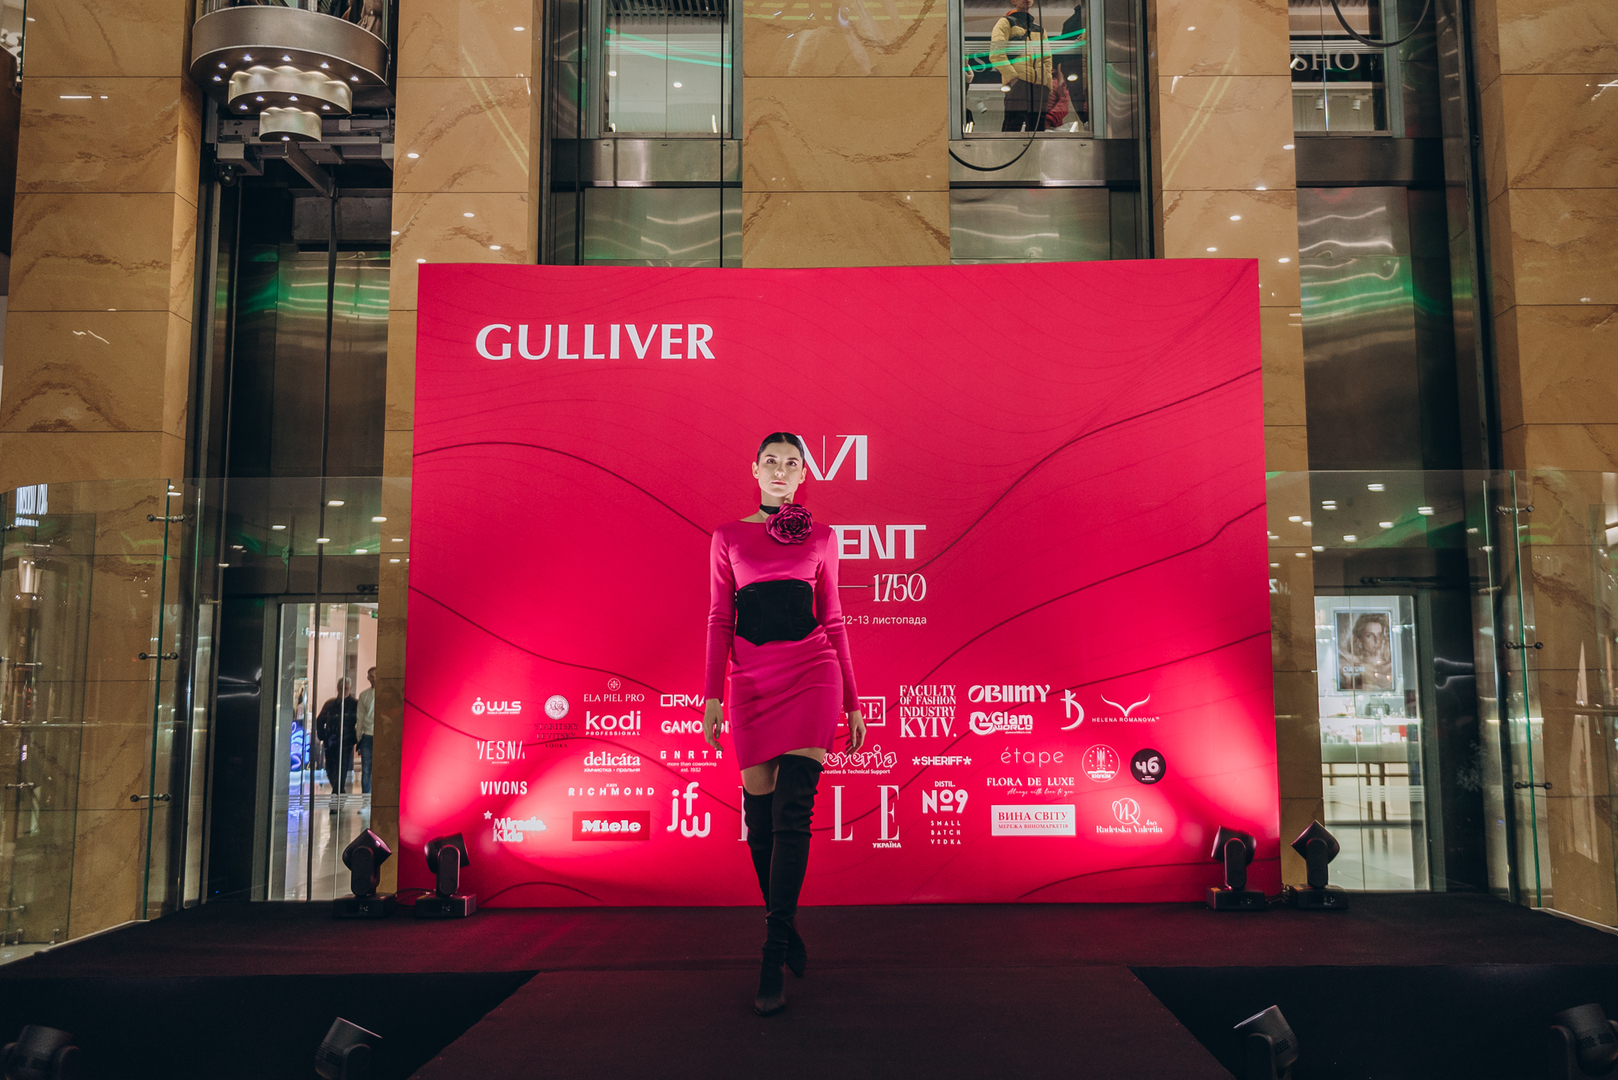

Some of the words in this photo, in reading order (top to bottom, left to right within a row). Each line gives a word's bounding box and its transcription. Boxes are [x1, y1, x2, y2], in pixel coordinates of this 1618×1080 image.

[475, 323, 716, 361] GULLIVER
[873, 573, 927, 602] 1750
[872, 616, 927, 626] листопада
[899, 684, 957, 697] FACULTY
[583, 694, 601, 703] ELA
[603, 694, 623, 703] PIEL
[625, 694, 645, 703] PRO
[899, 695, 913, 705] OF
[915, 695, 957, 705] FASHION
[486, 701, 522, 712] WLS
[899, 706, 957, 717] INDUSTRY
[585, 710, 641, 731] kodi
[991, 711, 1034, 725] Glam
[534, 723, 579, 731] STARITSKY
[899, 716, 957, 738] KYIV.
[536, 732, 576, 740] LEVITSKY
[583, 750, 641, 766] delicáta
[1000, 746, 1064, 768] étape
[480, 780, 528, 795] VIVONS
[986, 777, 1023, 787] FLORA
[1027, 777, 1042, 787] DE
[1047, 777, 1075, 787] LUXE
[568, 787, 655, 796] RICHMOND
[998, 811, 1031, 821] ВИНА
[1034, 811, 1068, 821] СВІТУ
[581, 820, 641, 832] Miele
[872, 841, 902, 849] УКРАЇНА
